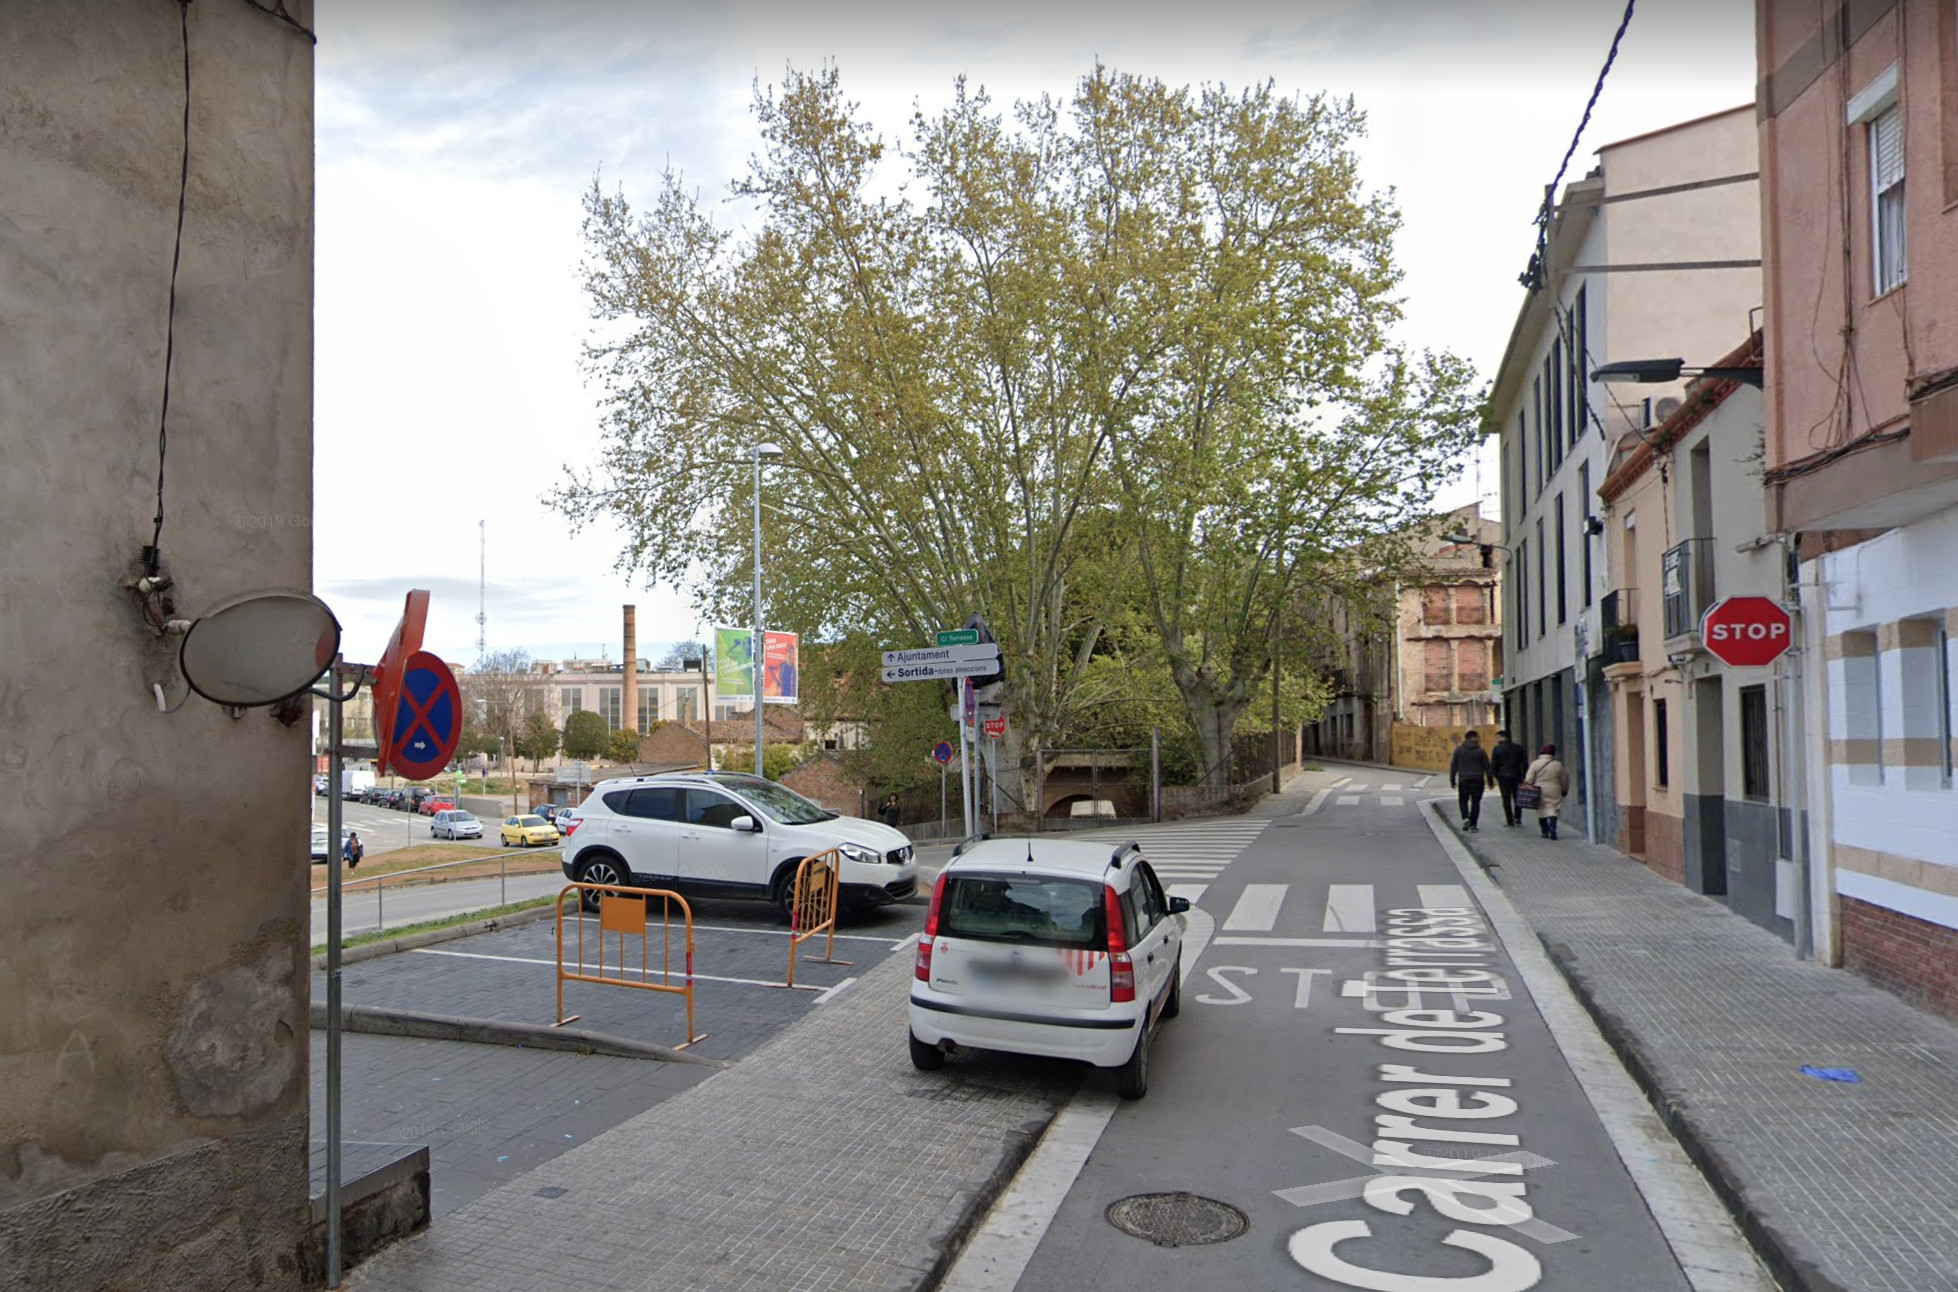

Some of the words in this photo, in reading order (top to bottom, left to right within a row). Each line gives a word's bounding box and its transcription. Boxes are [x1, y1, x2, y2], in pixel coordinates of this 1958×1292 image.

[1712, 623, 1786, 640] STOP
[897, 649, 950, 663] Ajuntament
[955, 665, 987, 674] direccions
